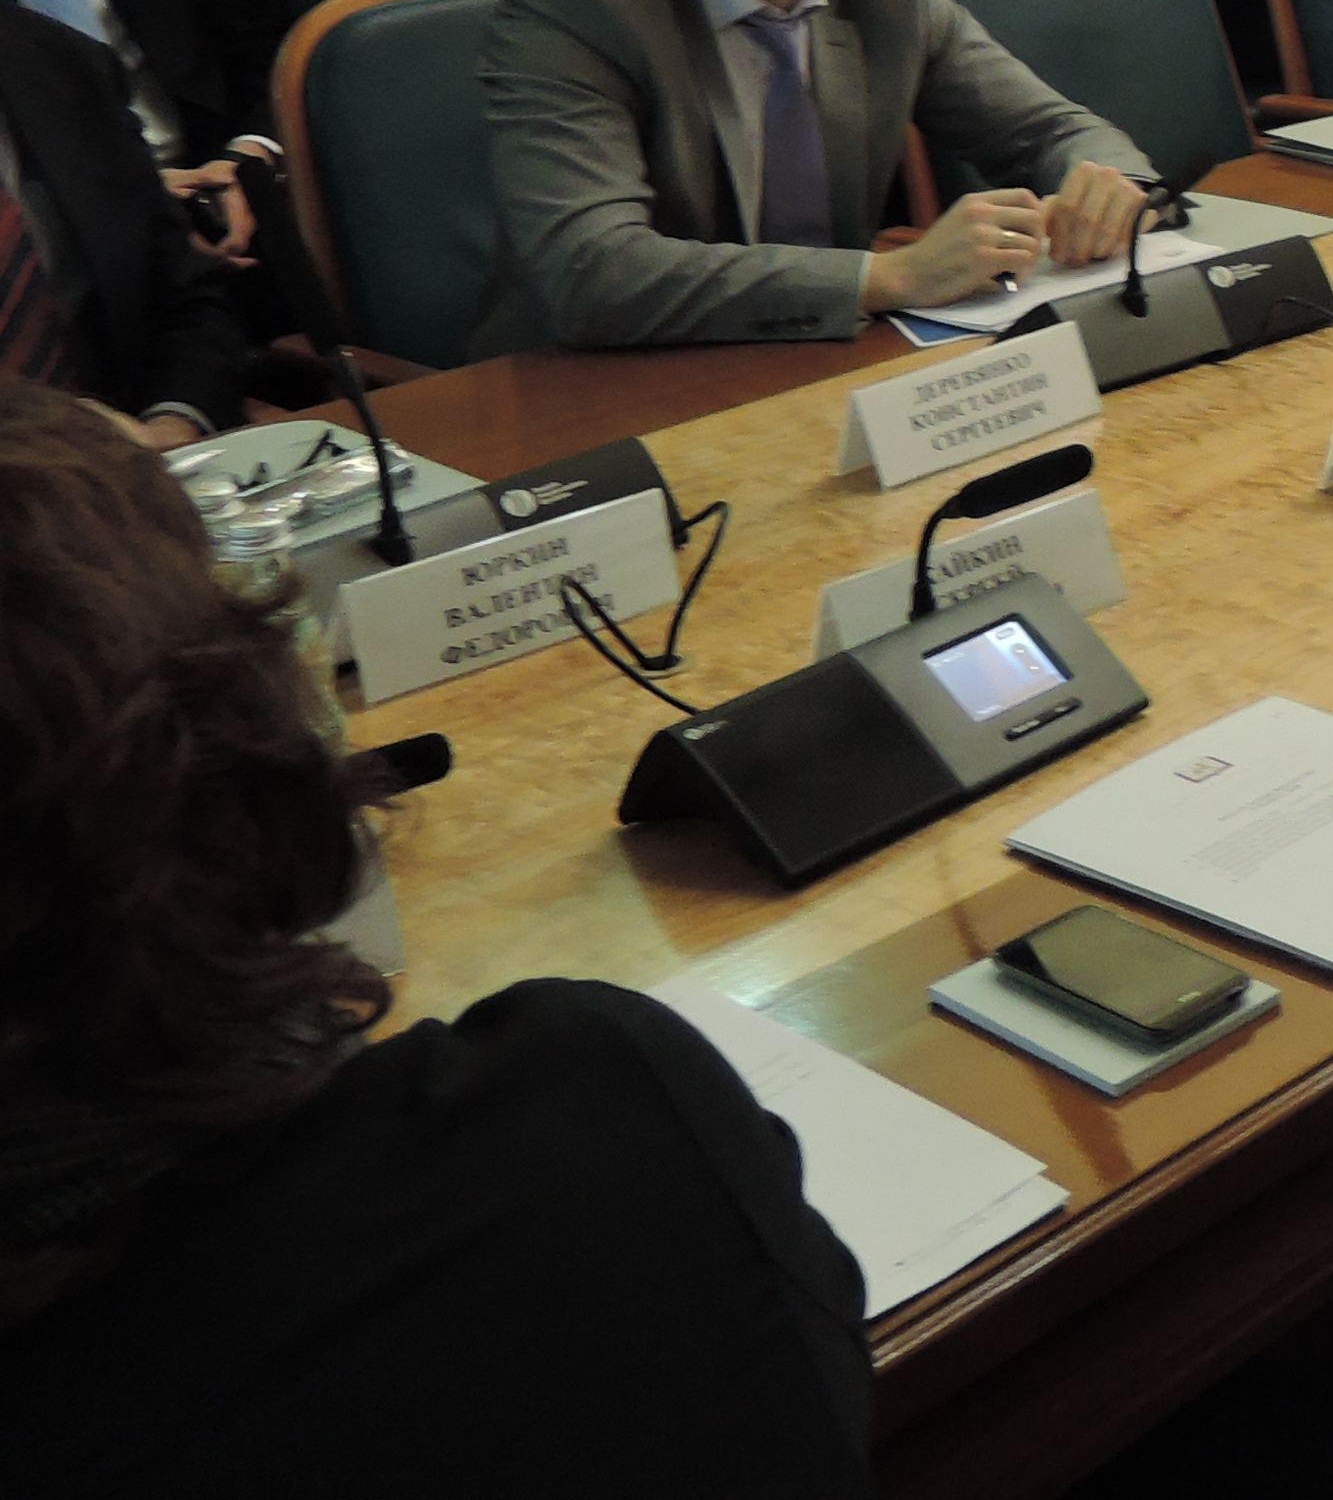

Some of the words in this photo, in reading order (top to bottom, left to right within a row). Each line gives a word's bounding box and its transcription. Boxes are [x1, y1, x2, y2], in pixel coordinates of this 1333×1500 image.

[908, 371, 1049, 431] КОНСТАНТИН
[930, 399, 1048, 451] СЕРГЕЕВИЧ
[461, 536, 569, 586] ЮРКИН
[439, 592, 616, 664] ФЕДОРОЧ
